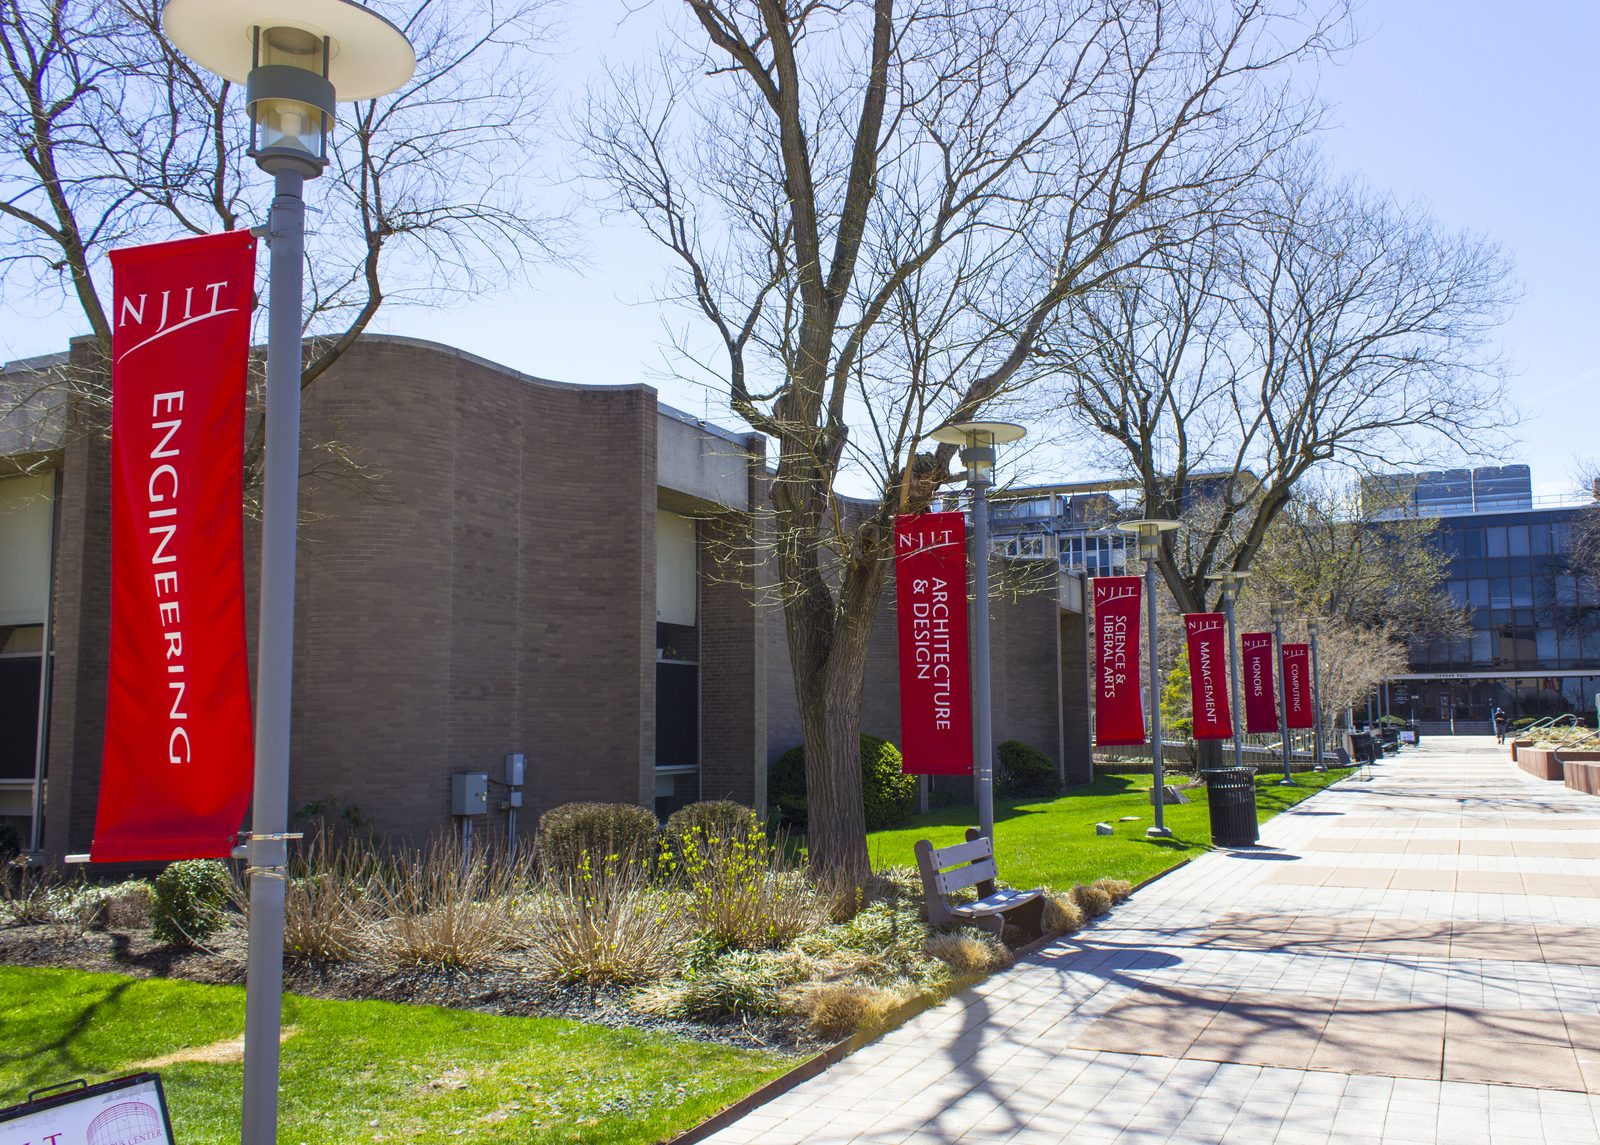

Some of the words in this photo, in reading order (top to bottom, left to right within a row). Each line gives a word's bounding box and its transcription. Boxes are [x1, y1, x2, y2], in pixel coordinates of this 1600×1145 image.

[118, 281, 228, 333] NJIT
[899, 530, 953, 550] NJIT
[148, 390, 191, 765] ENGINEERING
[912, 578, 929, 594] &
[1097, 586, 1135, 599] NJIT
[913, 603, 931, 679] DESIGN
[1103, 615, 1114, 664] LIBERAL
[1115, 615, 1127, 670] SCIENCE
[1188, 620, 1219, 631] NJIT
[1244, 639, 1268, 648] NJIT
[931, 577, 951, 730] ARCHITECTURE
[1283, 649, 1305, 657] NJIT
[1104, 666, 1116, 698] ARTS
[1115, 673, 1127, 684] &
[1200, 641, 1217, 724] MANAGEMENT
[1252, 657, 1263, 697] HONORS
[1291, 663, 1301, 712] COMPUTING
[128, 1129, 162, 1145] CENTER
